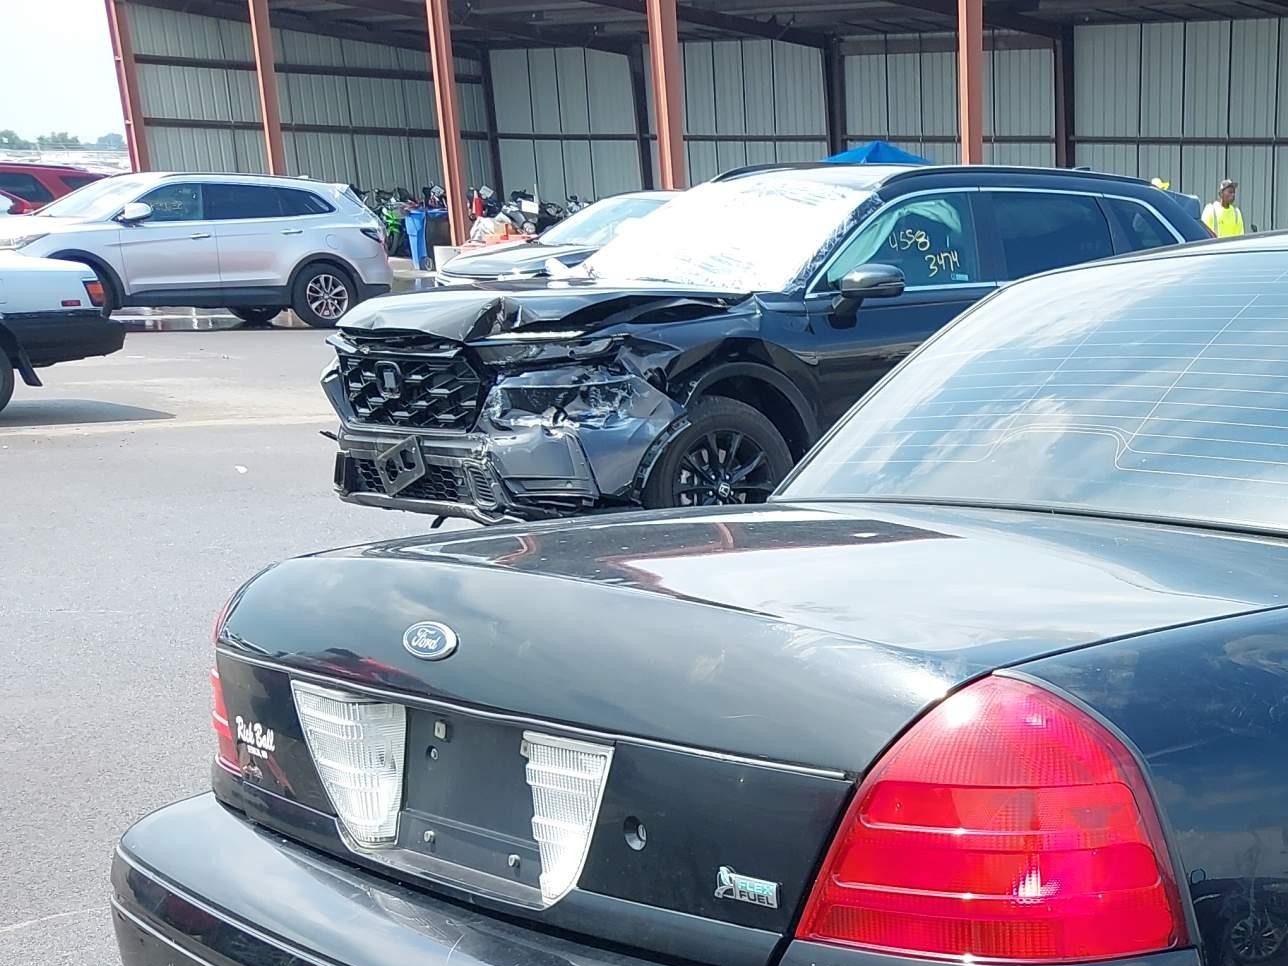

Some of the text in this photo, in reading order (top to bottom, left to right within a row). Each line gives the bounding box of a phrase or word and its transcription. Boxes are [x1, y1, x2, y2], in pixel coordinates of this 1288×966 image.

[889, 229, 930, 252] 4558
[924, 250, 960, 278] 3474
[411, 628, 441, 650] Ford
[737, 880, 773, 896] FLEX
[739, 890, 775, 907] FUEL
